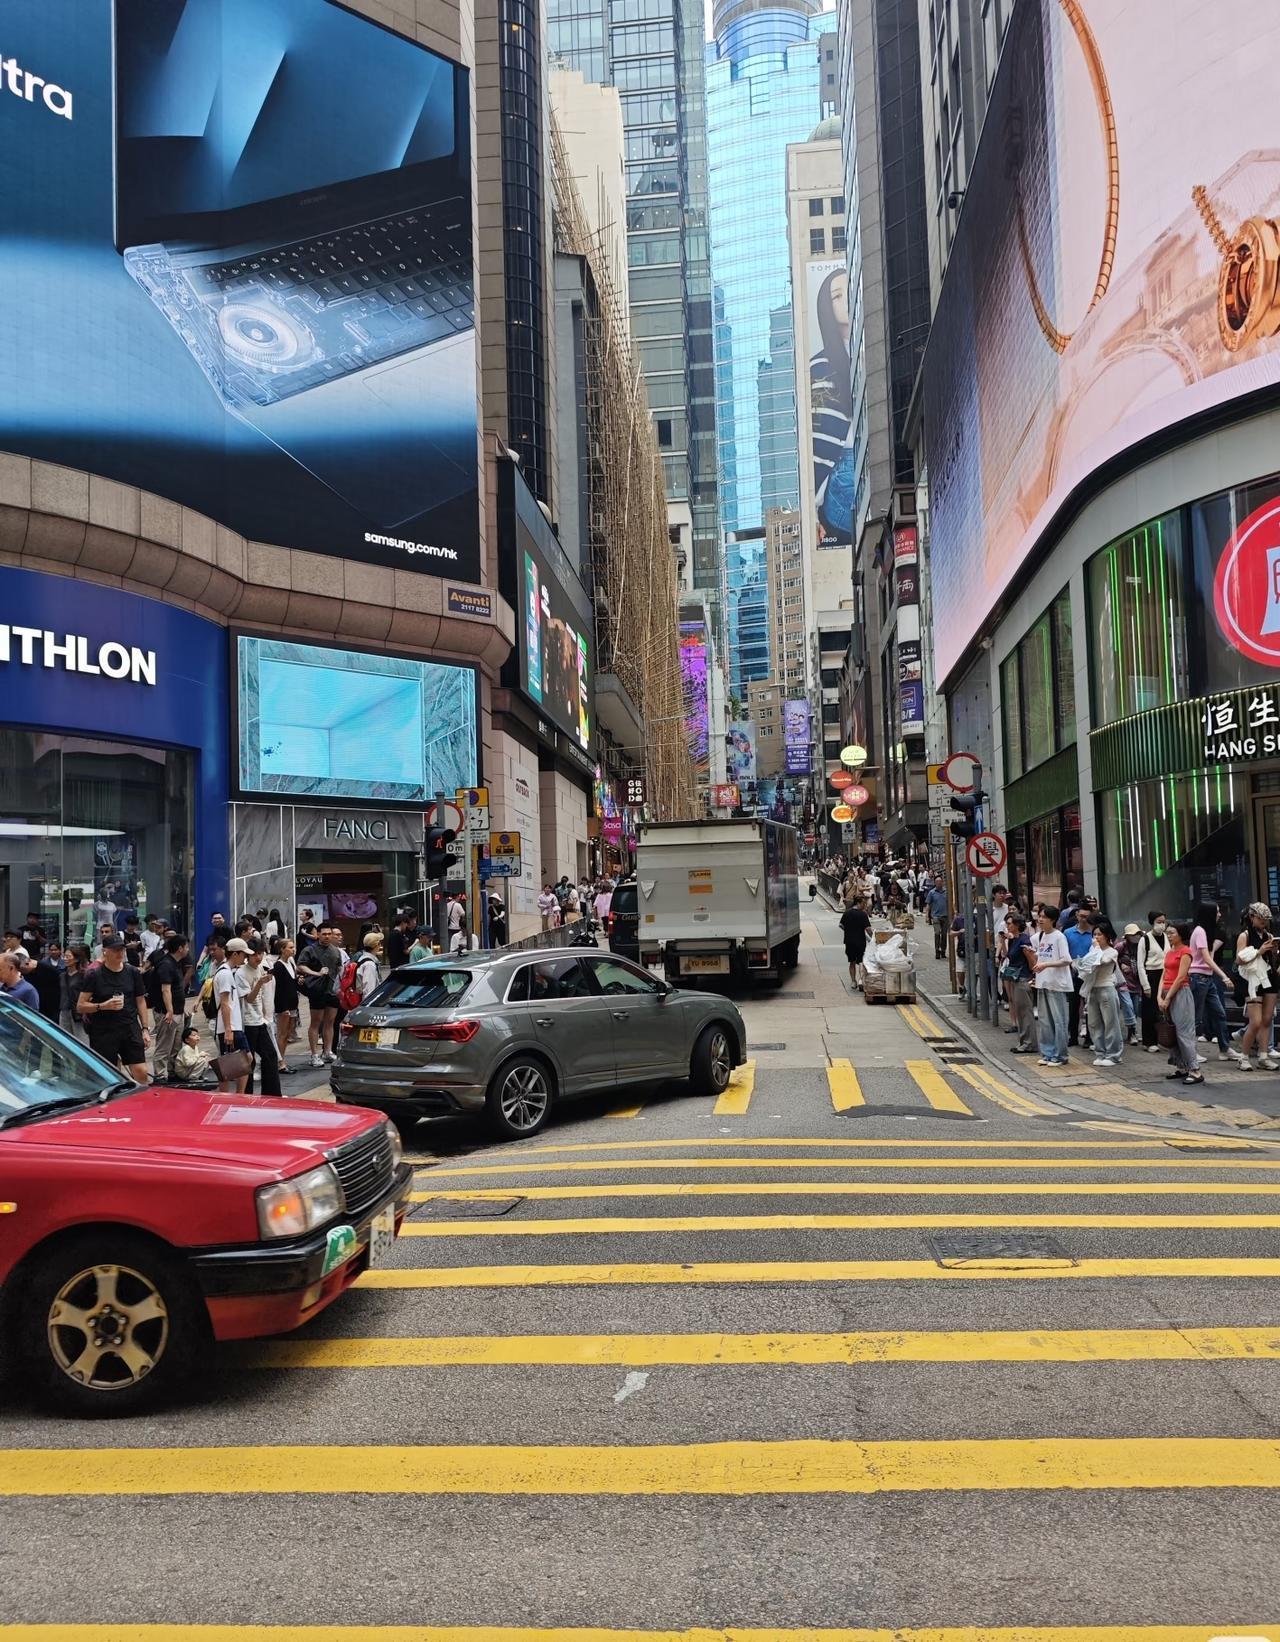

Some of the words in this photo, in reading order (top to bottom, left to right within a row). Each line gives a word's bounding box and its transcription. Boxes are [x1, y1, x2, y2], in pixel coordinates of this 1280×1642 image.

[0, 53, 72, 120] tra
[364, 532, 458, 560] samsung.com/hk
[450, 591, 490, 608] Avanti
[1201, 691, 1280, 737] 恒生
[1204, 737, 1257, 760] HANG
[477, 808, 483, 816] 7
[323, 817, 398, 841] FANCL
[477, 820, 483, 828] 7
[509, 856, 514, 864] 7
[976, 849, 994, 868] L
